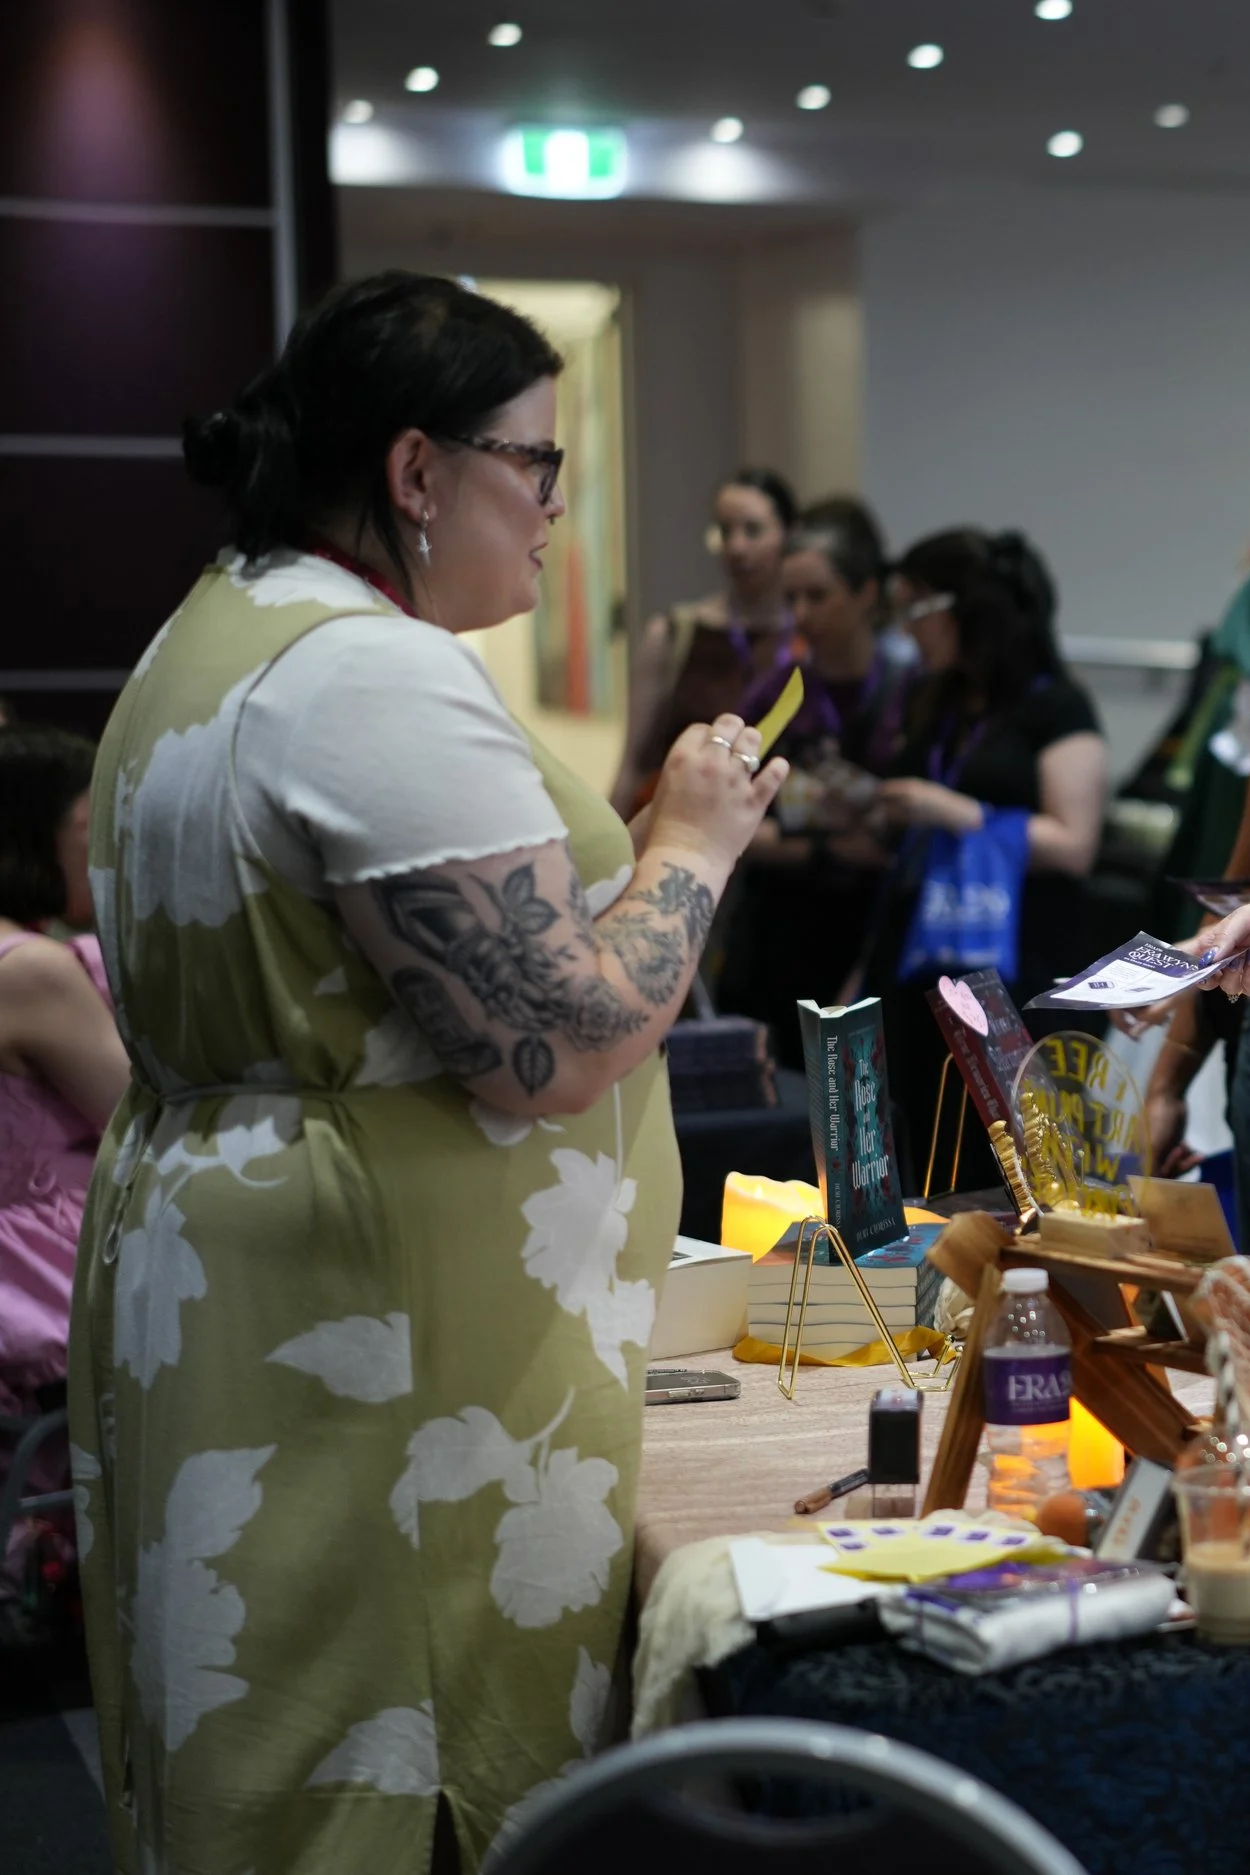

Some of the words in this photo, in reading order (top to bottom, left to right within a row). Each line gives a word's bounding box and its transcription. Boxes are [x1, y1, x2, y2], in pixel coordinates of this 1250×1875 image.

[1128, 951, 1174, 969] QUEST
[827, 1035, 838, 1052] The
[827, 1053, 838, 1075] Rose
[859, 1058, 869, 1076] The
[828, 1077, 839, 1093] and
[829, 1095, 840, 1113] Her
[854, 1079, 877, 1112] Rose
[829, 1113, 841, 1151] Warrior
[859, 1126, 876, 1157] Her
[852, 1153, 889, 1190] Warrior
